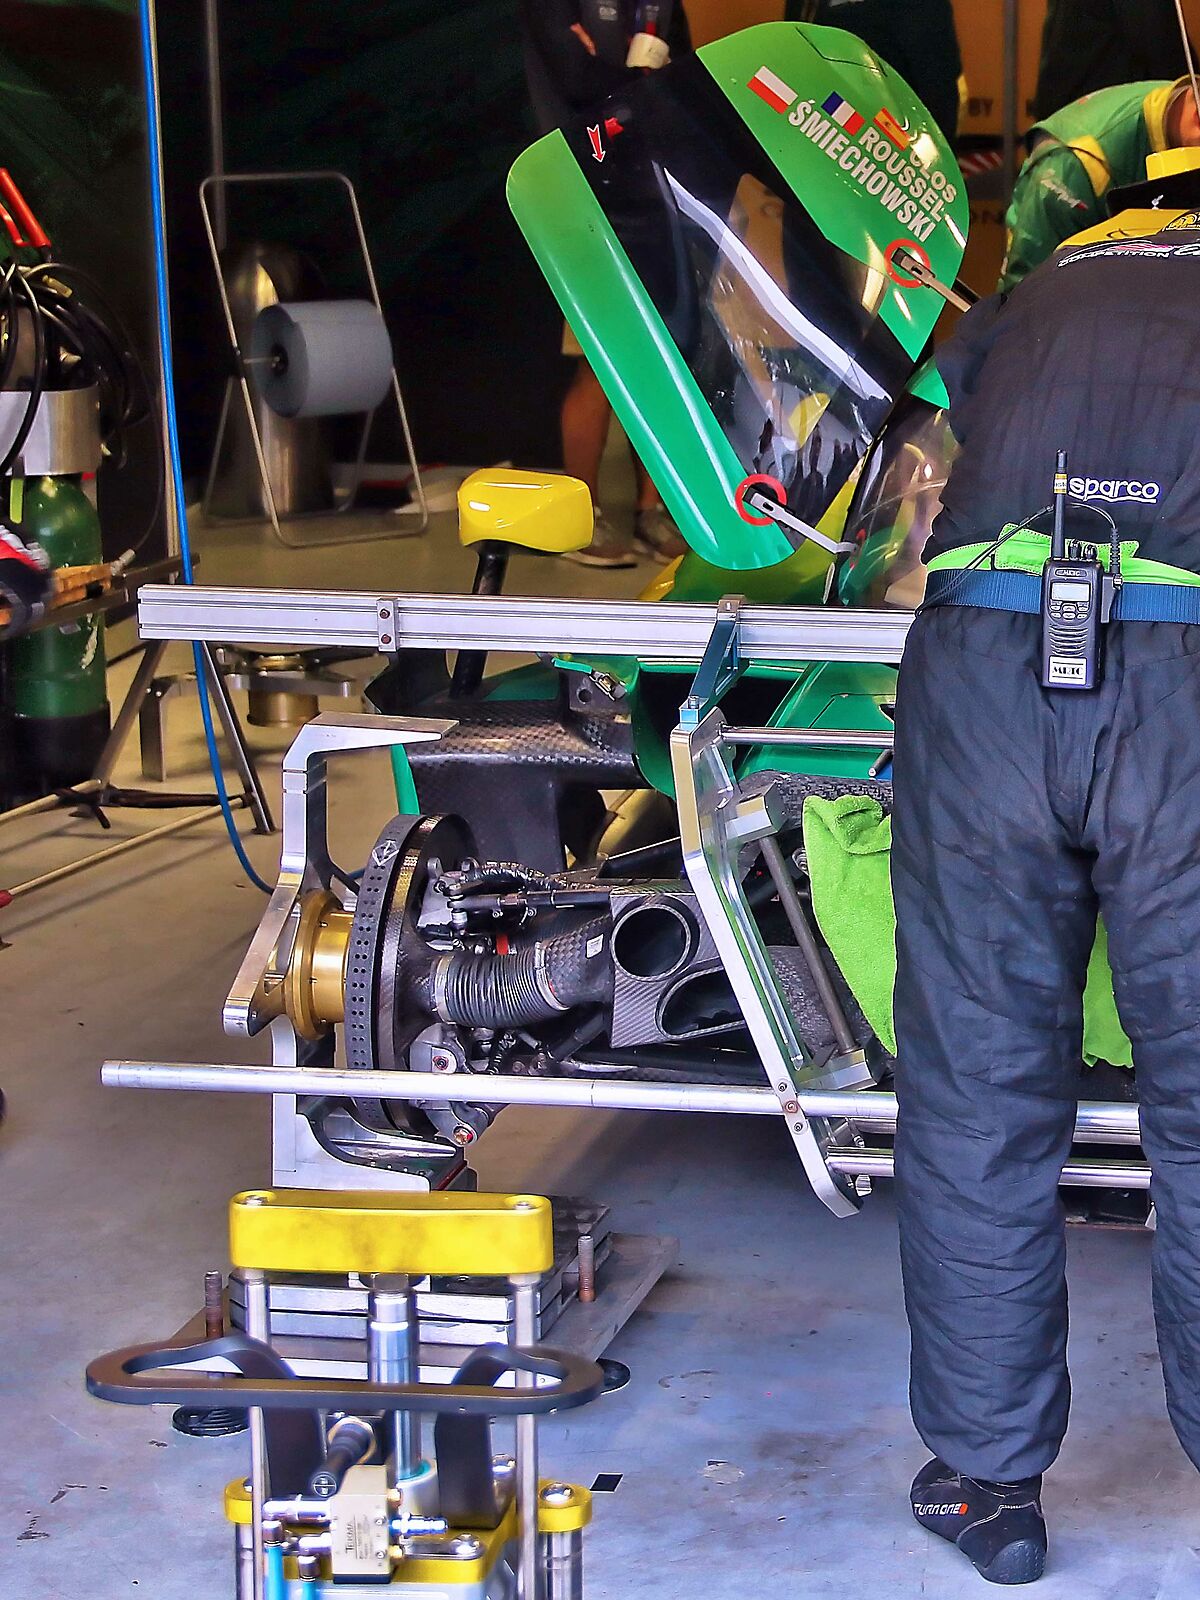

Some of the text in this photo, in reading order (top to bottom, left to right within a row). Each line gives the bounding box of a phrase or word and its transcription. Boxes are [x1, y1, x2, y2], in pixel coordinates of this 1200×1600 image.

[788, 99, 937, 243] ŚMIECHOWSKI
[858, 126, 946, 222] ROUSSEL
[1068, 477, 1160, 502] sparco
